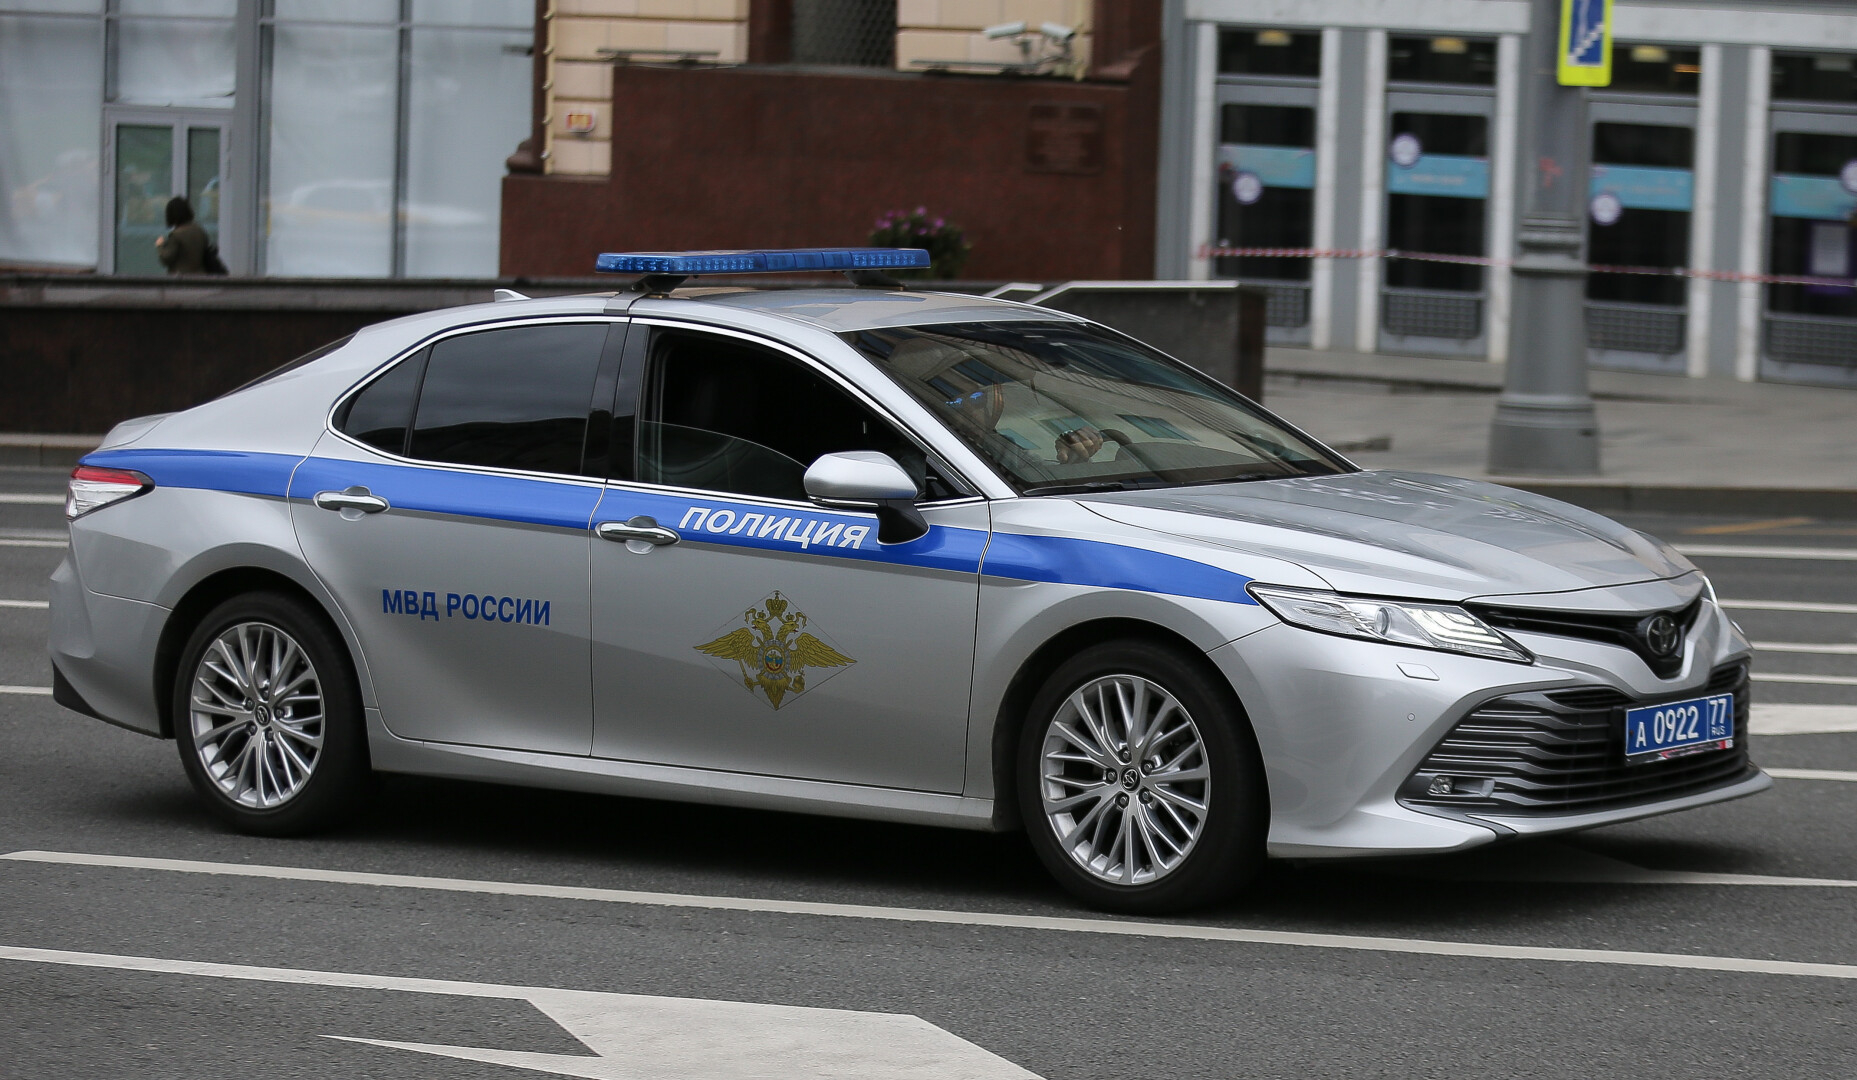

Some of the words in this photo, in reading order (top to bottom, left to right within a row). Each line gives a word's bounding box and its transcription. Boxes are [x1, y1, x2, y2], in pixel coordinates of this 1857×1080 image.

[678, 506, 871, 550] ПОЛИЦИЯ
[382, 589, 440, 622] МВД
[446, 593, 551, 626] РОССИИ
[1653, 706, 1699, 744] 0922
[1709, 698, 1727, 725] 77
[1711, 725, 1726, 736] RUS
